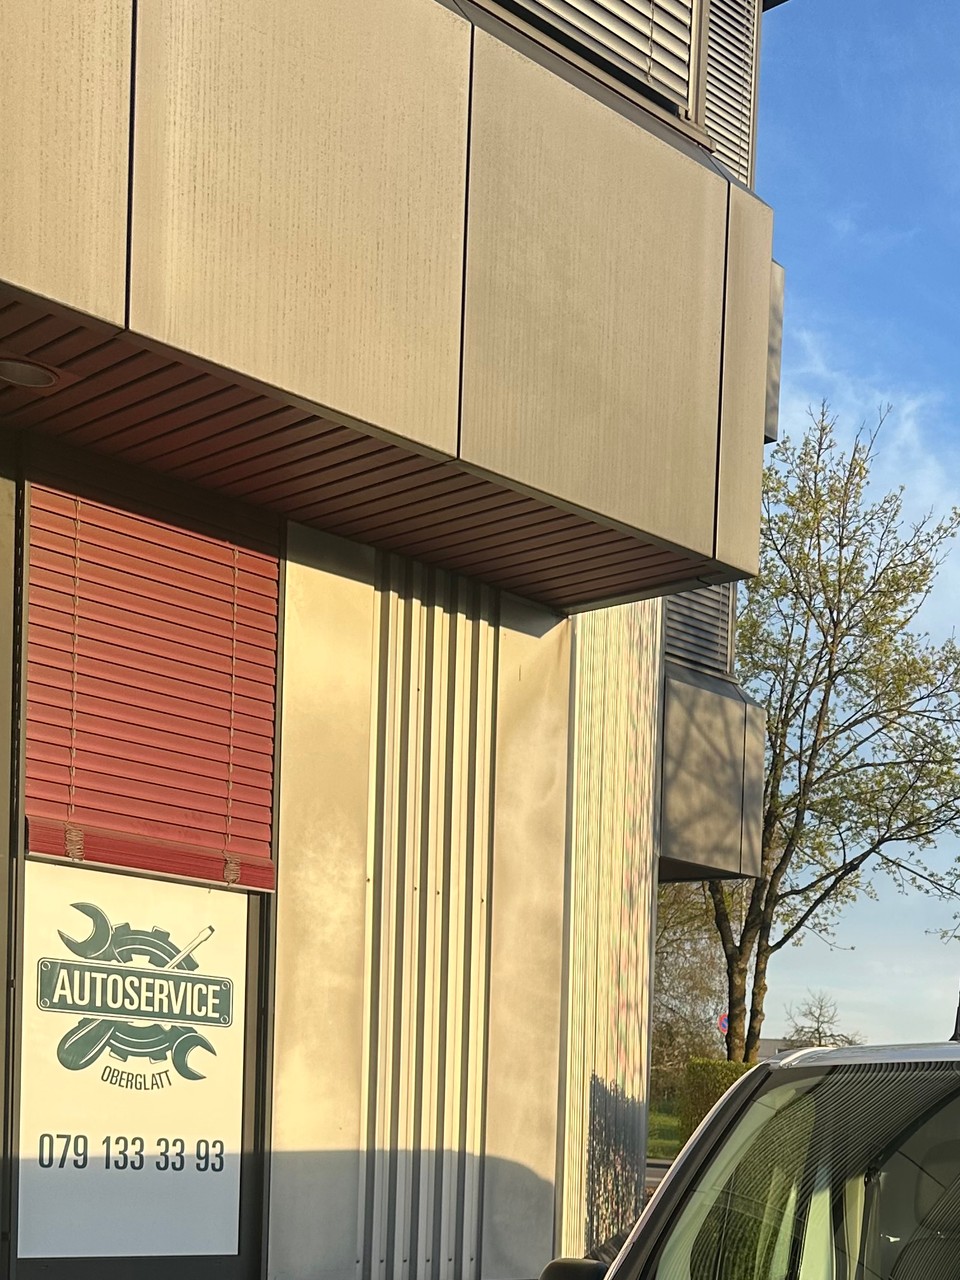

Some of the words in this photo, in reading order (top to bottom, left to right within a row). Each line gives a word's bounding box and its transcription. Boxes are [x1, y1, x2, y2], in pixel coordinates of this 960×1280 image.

[53, 968, 221, 1018] AUTOSERVICE
[101, 1065, 173, 1090] OBERGLATT
[38, 1133, 89, 1169] 079
[101, 1135, 145, 1171] 133
[155, 1137, 186, 1172] 33
[195, 1139, 225, 1173] 93
